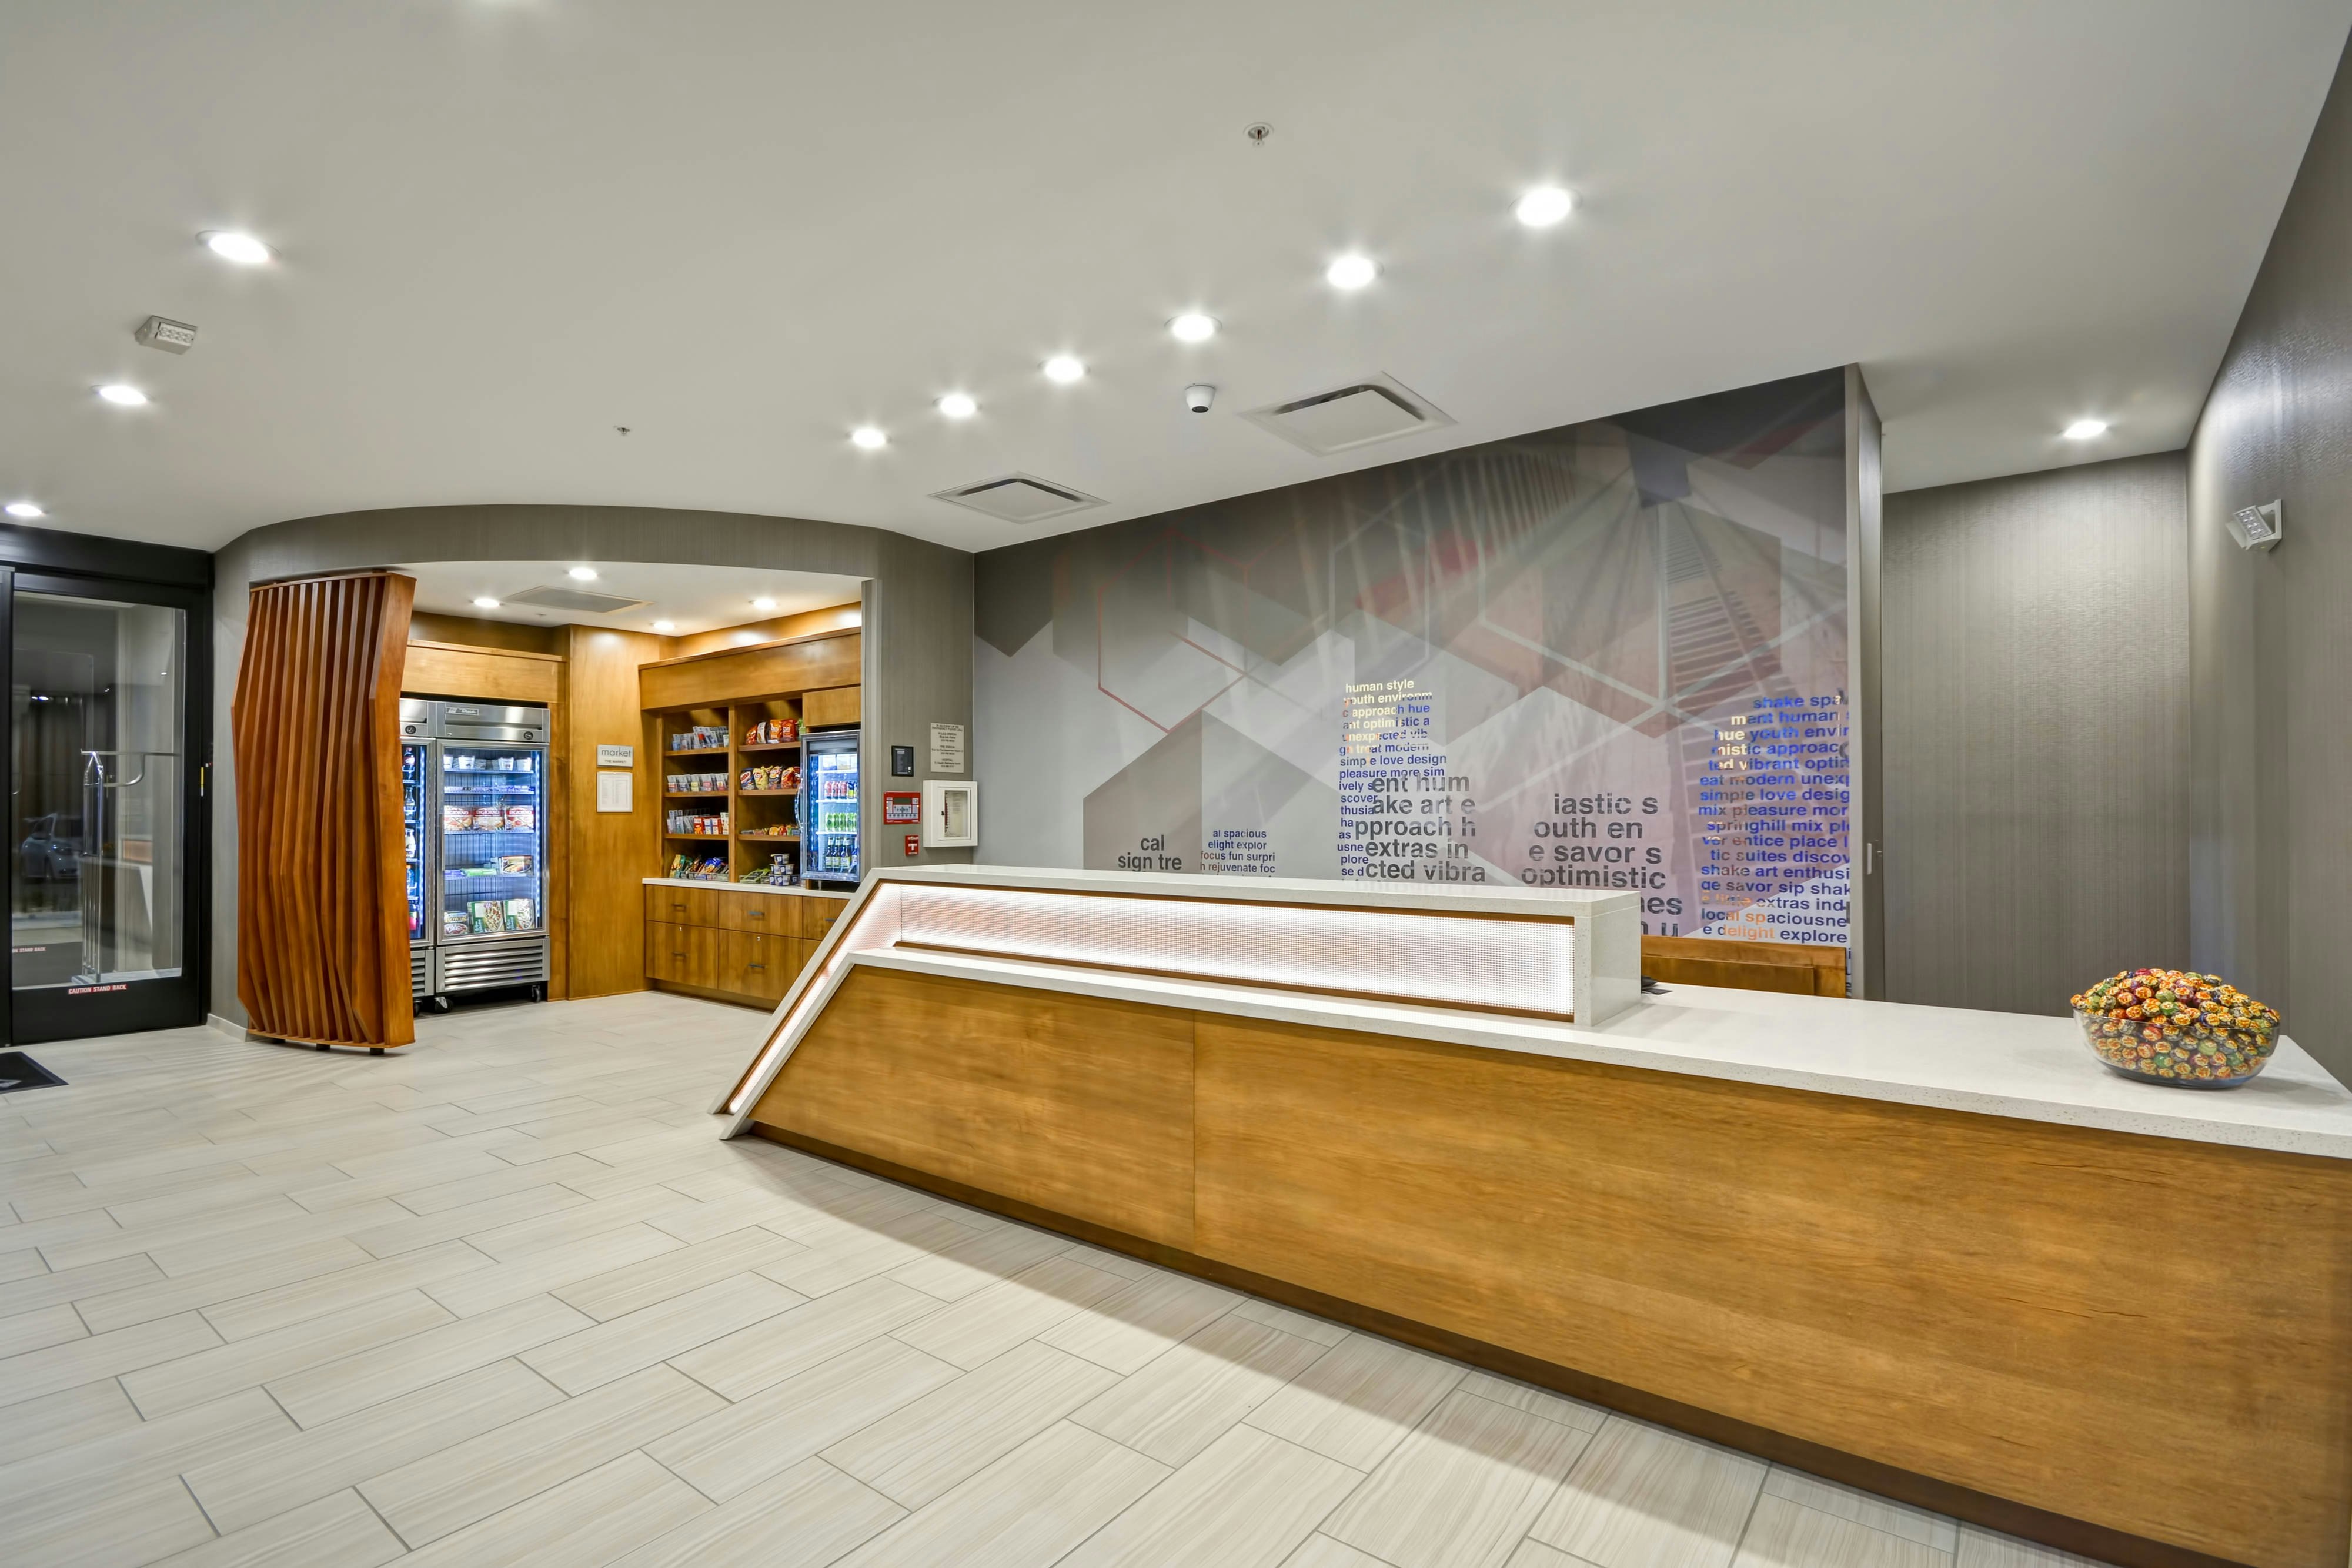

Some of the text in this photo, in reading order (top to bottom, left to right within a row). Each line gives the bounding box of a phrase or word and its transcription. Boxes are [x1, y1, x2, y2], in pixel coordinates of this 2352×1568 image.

[1346, 679, 1414, 693] human style
[1344, 693, 1375, 708] youth
[1753, 695, 1805, 709] shake
[1352, 704, 1404, 718] approach
[1409, 704, 1430, 713] hue
[1343, 720, 1360, 729] ant
[1364, 717, 1419, 730] optimistic
[1731, 712, 1773, 726] ment
[1779, 711, 1840, 723] human
[1714, 724, 1849, 743] hue youth envir
[602, 747, 632, 758] market
[1712, 743, 1762, 756] mistic
[1767, 743, 1839, 756] approac
[1380, 755, 1404, 764] love
[1407, 754, 1446, 766] design
[1709, 758, 1734, 771] ted
[1739, 758, 1799, 771] vibrant
[1339, 767, 1444, 780] pleasure more sim
[1700, 775, 1725, 786] eat
[1730, 774, 1795, 785] modern
[1339, 781, 1364, 793] ively
[1372, 773, 1469, 793] ent hum
[1341, 795, 1378, 803] scover
[1700, 788, 1850, 803] simple love desig
[1341, 805, 1375, 815] thusia
[1372, 795, 1475, 815] ake art e
[1554, 793, 1659, 814] iastic s
[1699, 804, 1848, 819] mix pleasure mor
[1341, 818, 1354, 827] ha
[1355, 817, 1475, 840] pproach h
[1534, 817, 1643, 838] outh en
[1707, 819, 1786, 834] springhill
[1792, 820, 1823, 831] mix
[1224, 829, 1267, 840] spacious
[1141, 834, 1164, 851] cal
[1208, 840, 1267, 851] elight explor
[1365, 839, 1469, 858] extras in
[1733, 835, 1784, 847] entice
[1790, 835, 1838, 850] place
[1201, 851, 1275, 863] focus fun surpri
[1341, 854, 1369, 865] plore
[1529, 845, 1662, 864] e savor s
[1711, 849, 1730, 861] tic
[1736, 850, 1787, 862] suites
[1118, 852, 1182, 872] sign tre
[1209, 862, 1257, 873] rejuvenate
[1260, 864, 1275, 873] foc
[1341, 867, 1364, 876] se d
[1366, 860, 1485, 882] cted vibra
[1521, 864, 1666, 889] optimistic
[1701, 865, 1850, 880] shake art enthusi
[1726, 882, 1773, 892] savor
[1779, 883, 1805, 896] sip
[1756, 898, 1809, 910] extras
[1816, 898, 1843, 911] ind
[1702, 908, 1739, 921] local
[1746, 912, 1847, 927] spaciousne
[1703, 924, 1847, 944] e delight explore
